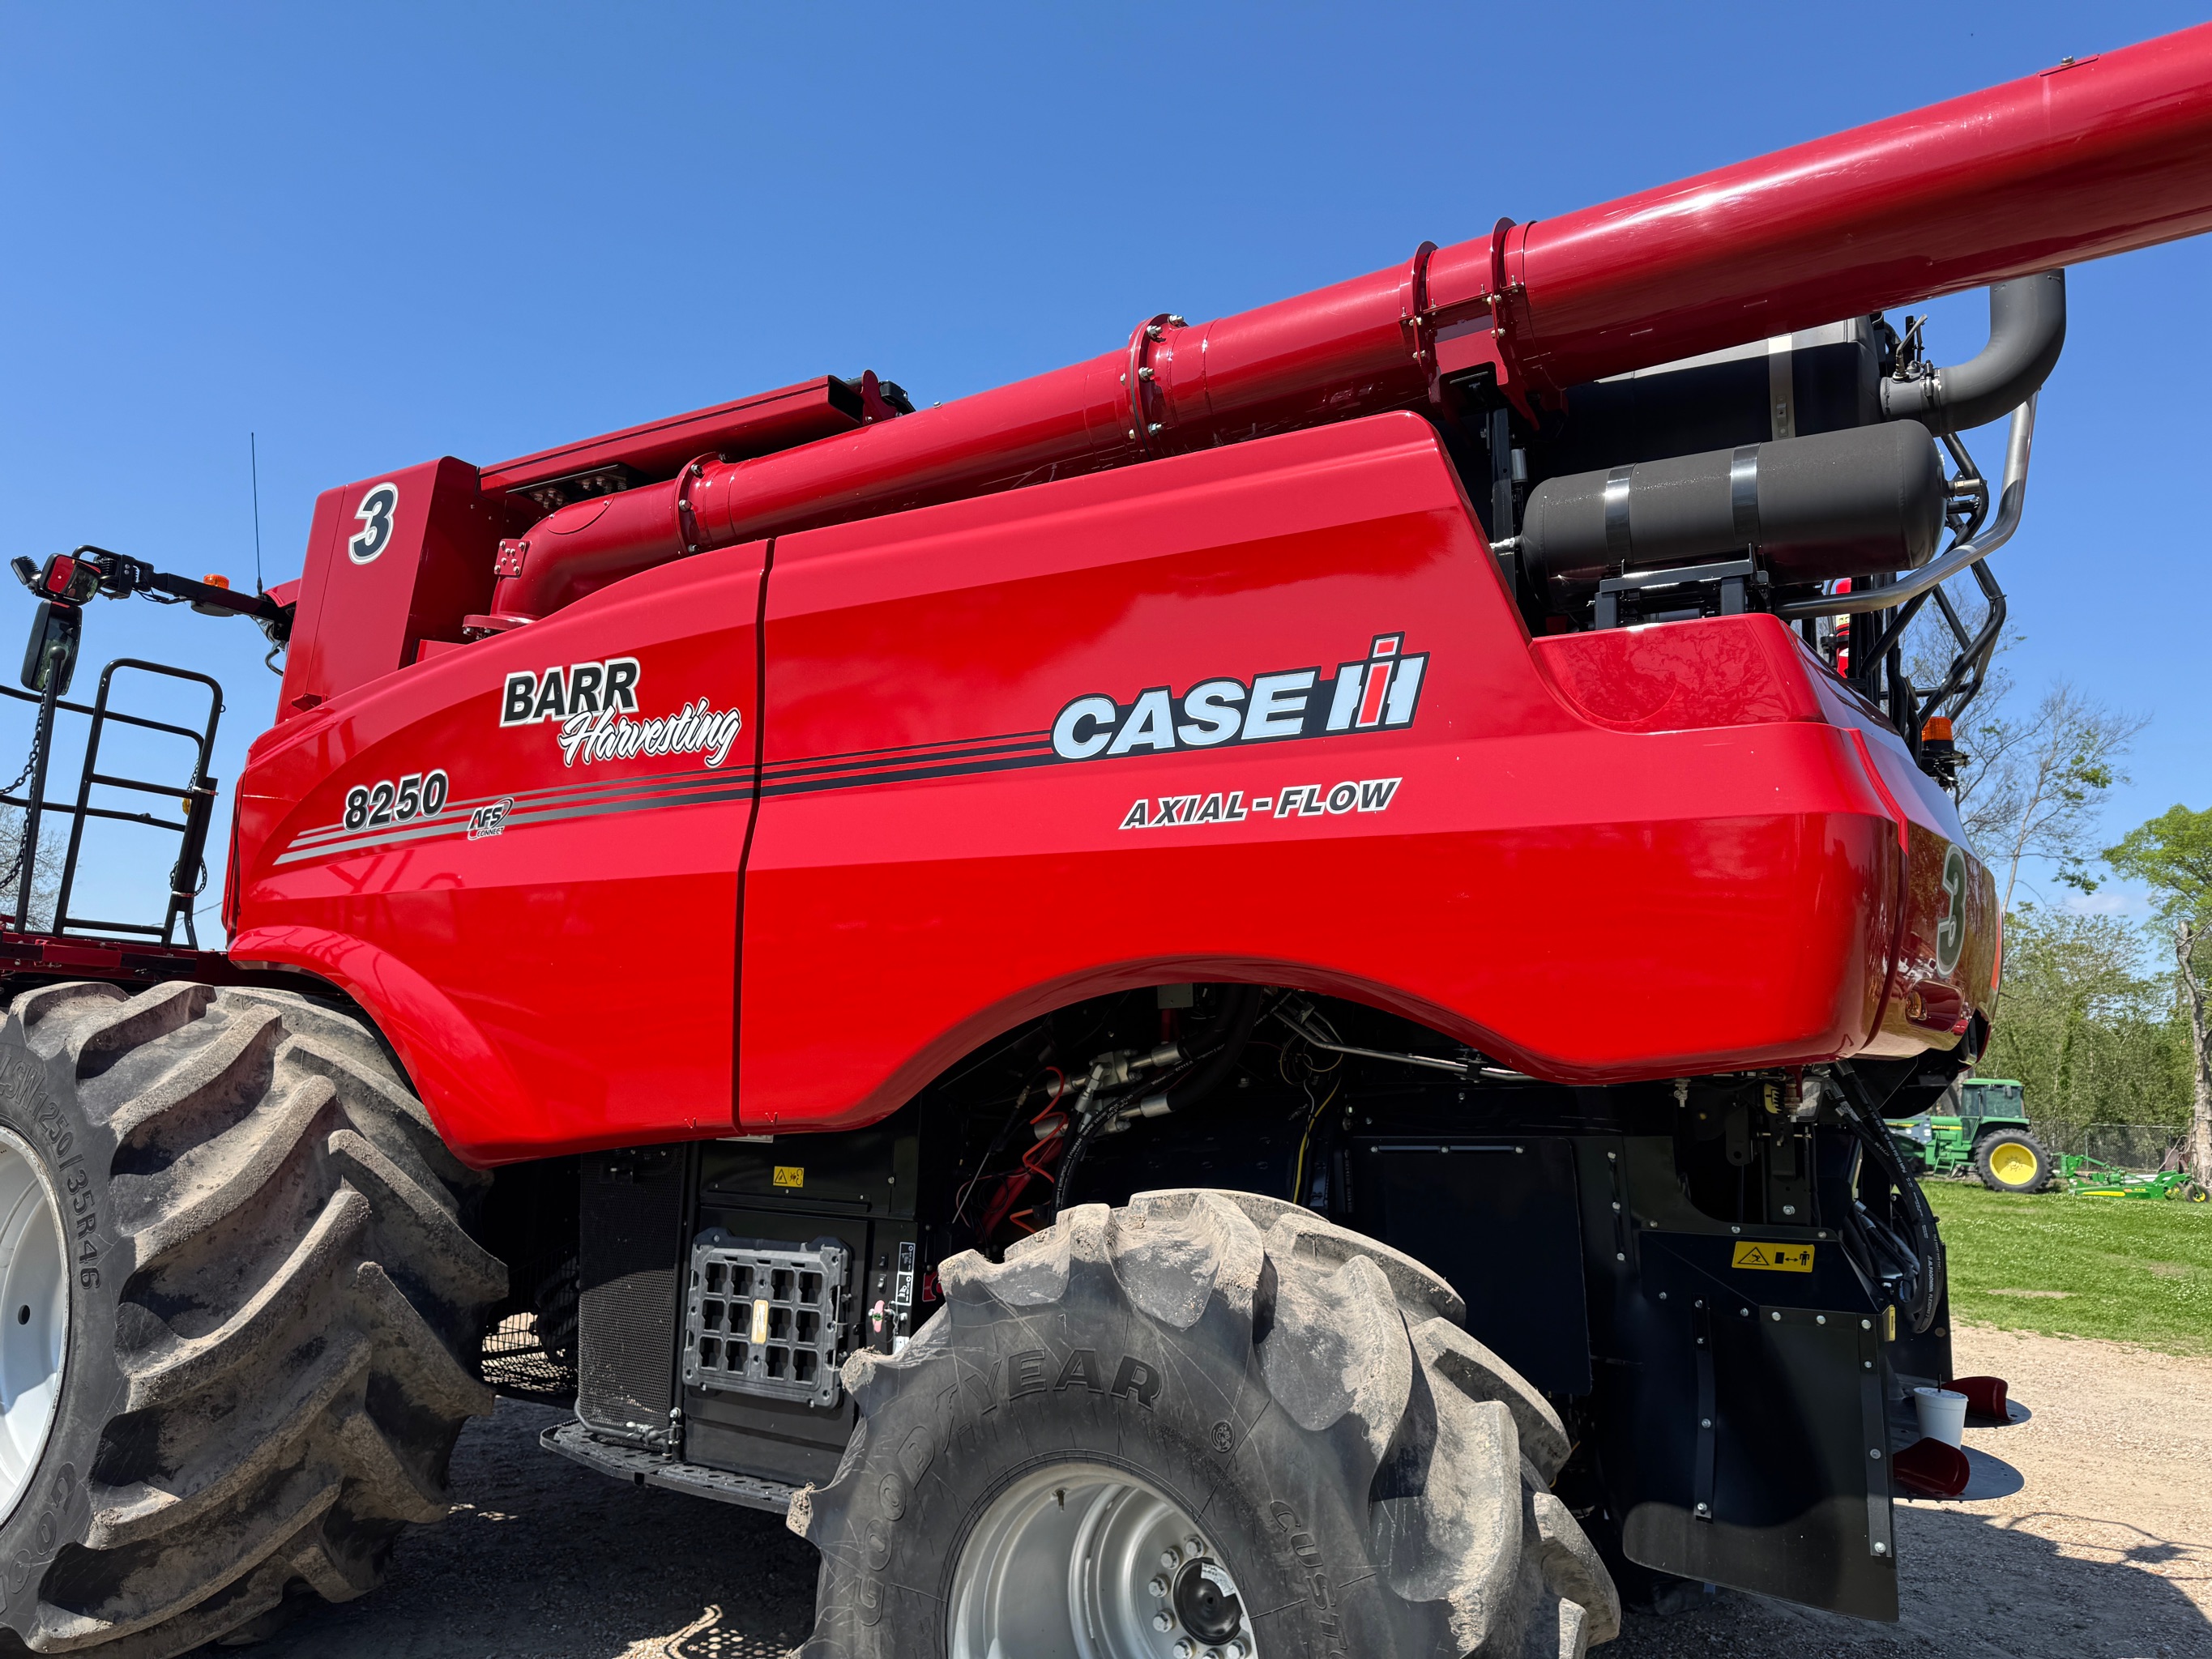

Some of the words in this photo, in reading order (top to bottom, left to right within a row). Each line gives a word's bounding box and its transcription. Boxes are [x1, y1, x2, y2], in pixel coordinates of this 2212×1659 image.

[348, 482, 398, 565] 3
[500, 657, 640, 727] BARR
[1053, 672, 1315, 759] CASE
[558, 697, 741, 768] Harvesting
[343, 769, 448, 832] 8250
[468, 804, 504, 830] AFS
[476, 826, 505, 838] CONNECT
[1118, 778, 1403, 830] AXIAL-FLOW
[1937, 842, 1966, 978] 3
[853, 1348, 1163, 1627] GOODYEAR
